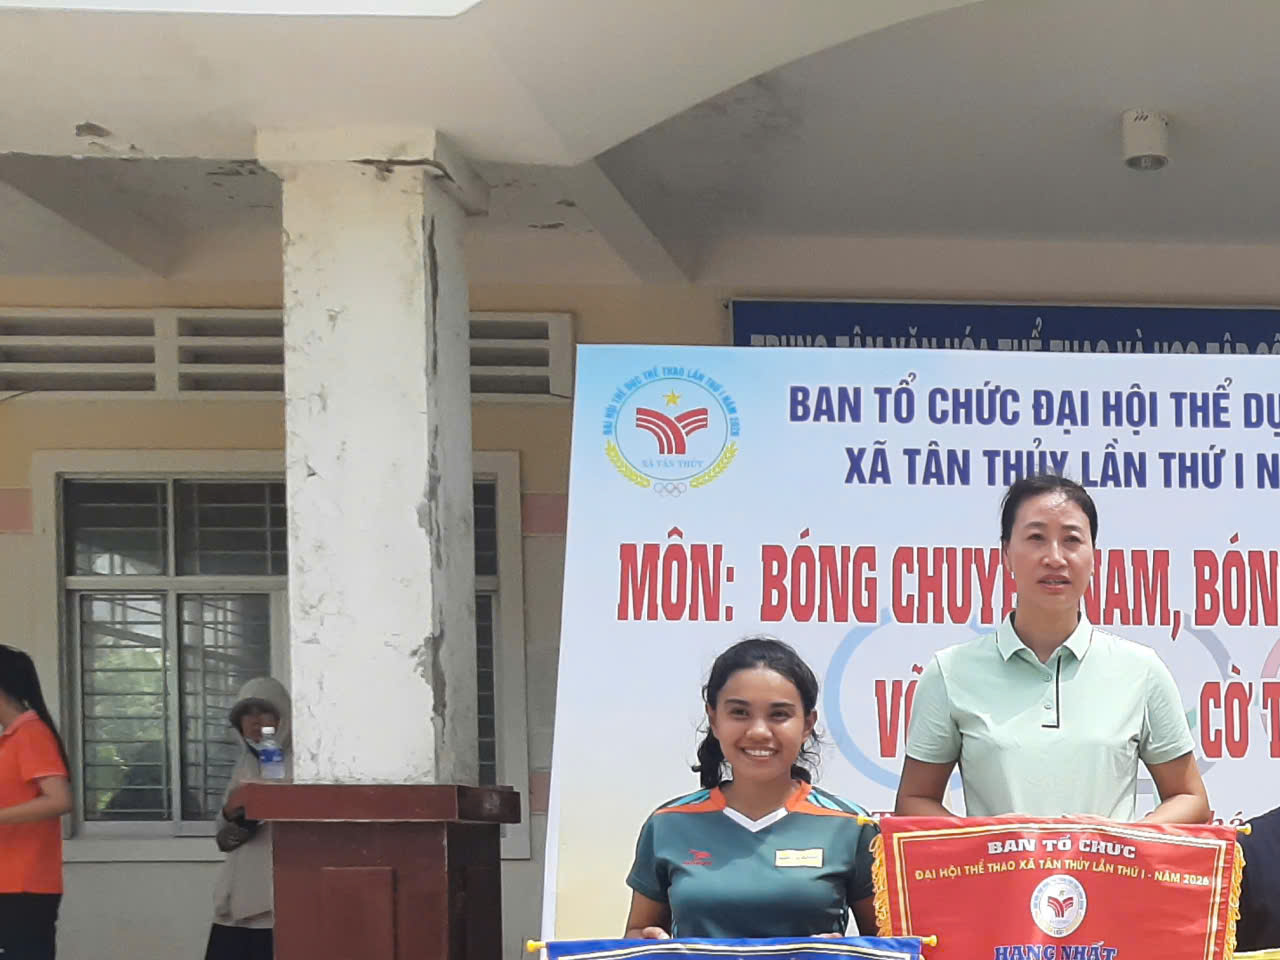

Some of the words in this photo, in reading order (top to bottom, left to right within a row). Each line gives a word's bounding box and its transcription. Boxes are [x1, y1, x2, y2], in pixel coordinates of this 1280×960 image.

[789, 385, 862, 423] BAN
[873, 372, 919, 424] TỔ
[928, 382, 1021, 426] CHỨC
[1032, 388, 1089, 435] ĐẠI
[1103, 384, 1158, 436] HỘI
[1170, 377, 1232, 429] THỂ
[844, 440, 890, 485] XÃ
[903, 441, 970, 486] TÂN
[983, 437, 1069, 486] THỦY
[1081, 438, 1147, 488] LẦN
[1159, 444, 1227, 489] THỨ
[1235, 452, 1244, 489] I
[618, 526, 735, 621] MÔN:
[761, 528, 878, 622] BÓNG
[893, 547, 1017, 624] CHUY
[1200, 665, 1253, 759] CỜ
[939, 865, 961, 879] HỘI
[964, 858, 984, 875] THỂ
[987, 861, 1016, 872] THAO
[1019, 857, 1035, 870] XÃ
[1039, 857, 1061, 869] TÂN
[1154, 869, 1180, 883] NĂM
[1183, 874, 1210, 885] 2026
[987, 839, 1036, 854] BAN
[1042, 835, 1072, 852] TỔ
[1079, 838, 1136, 858] CHỨC
